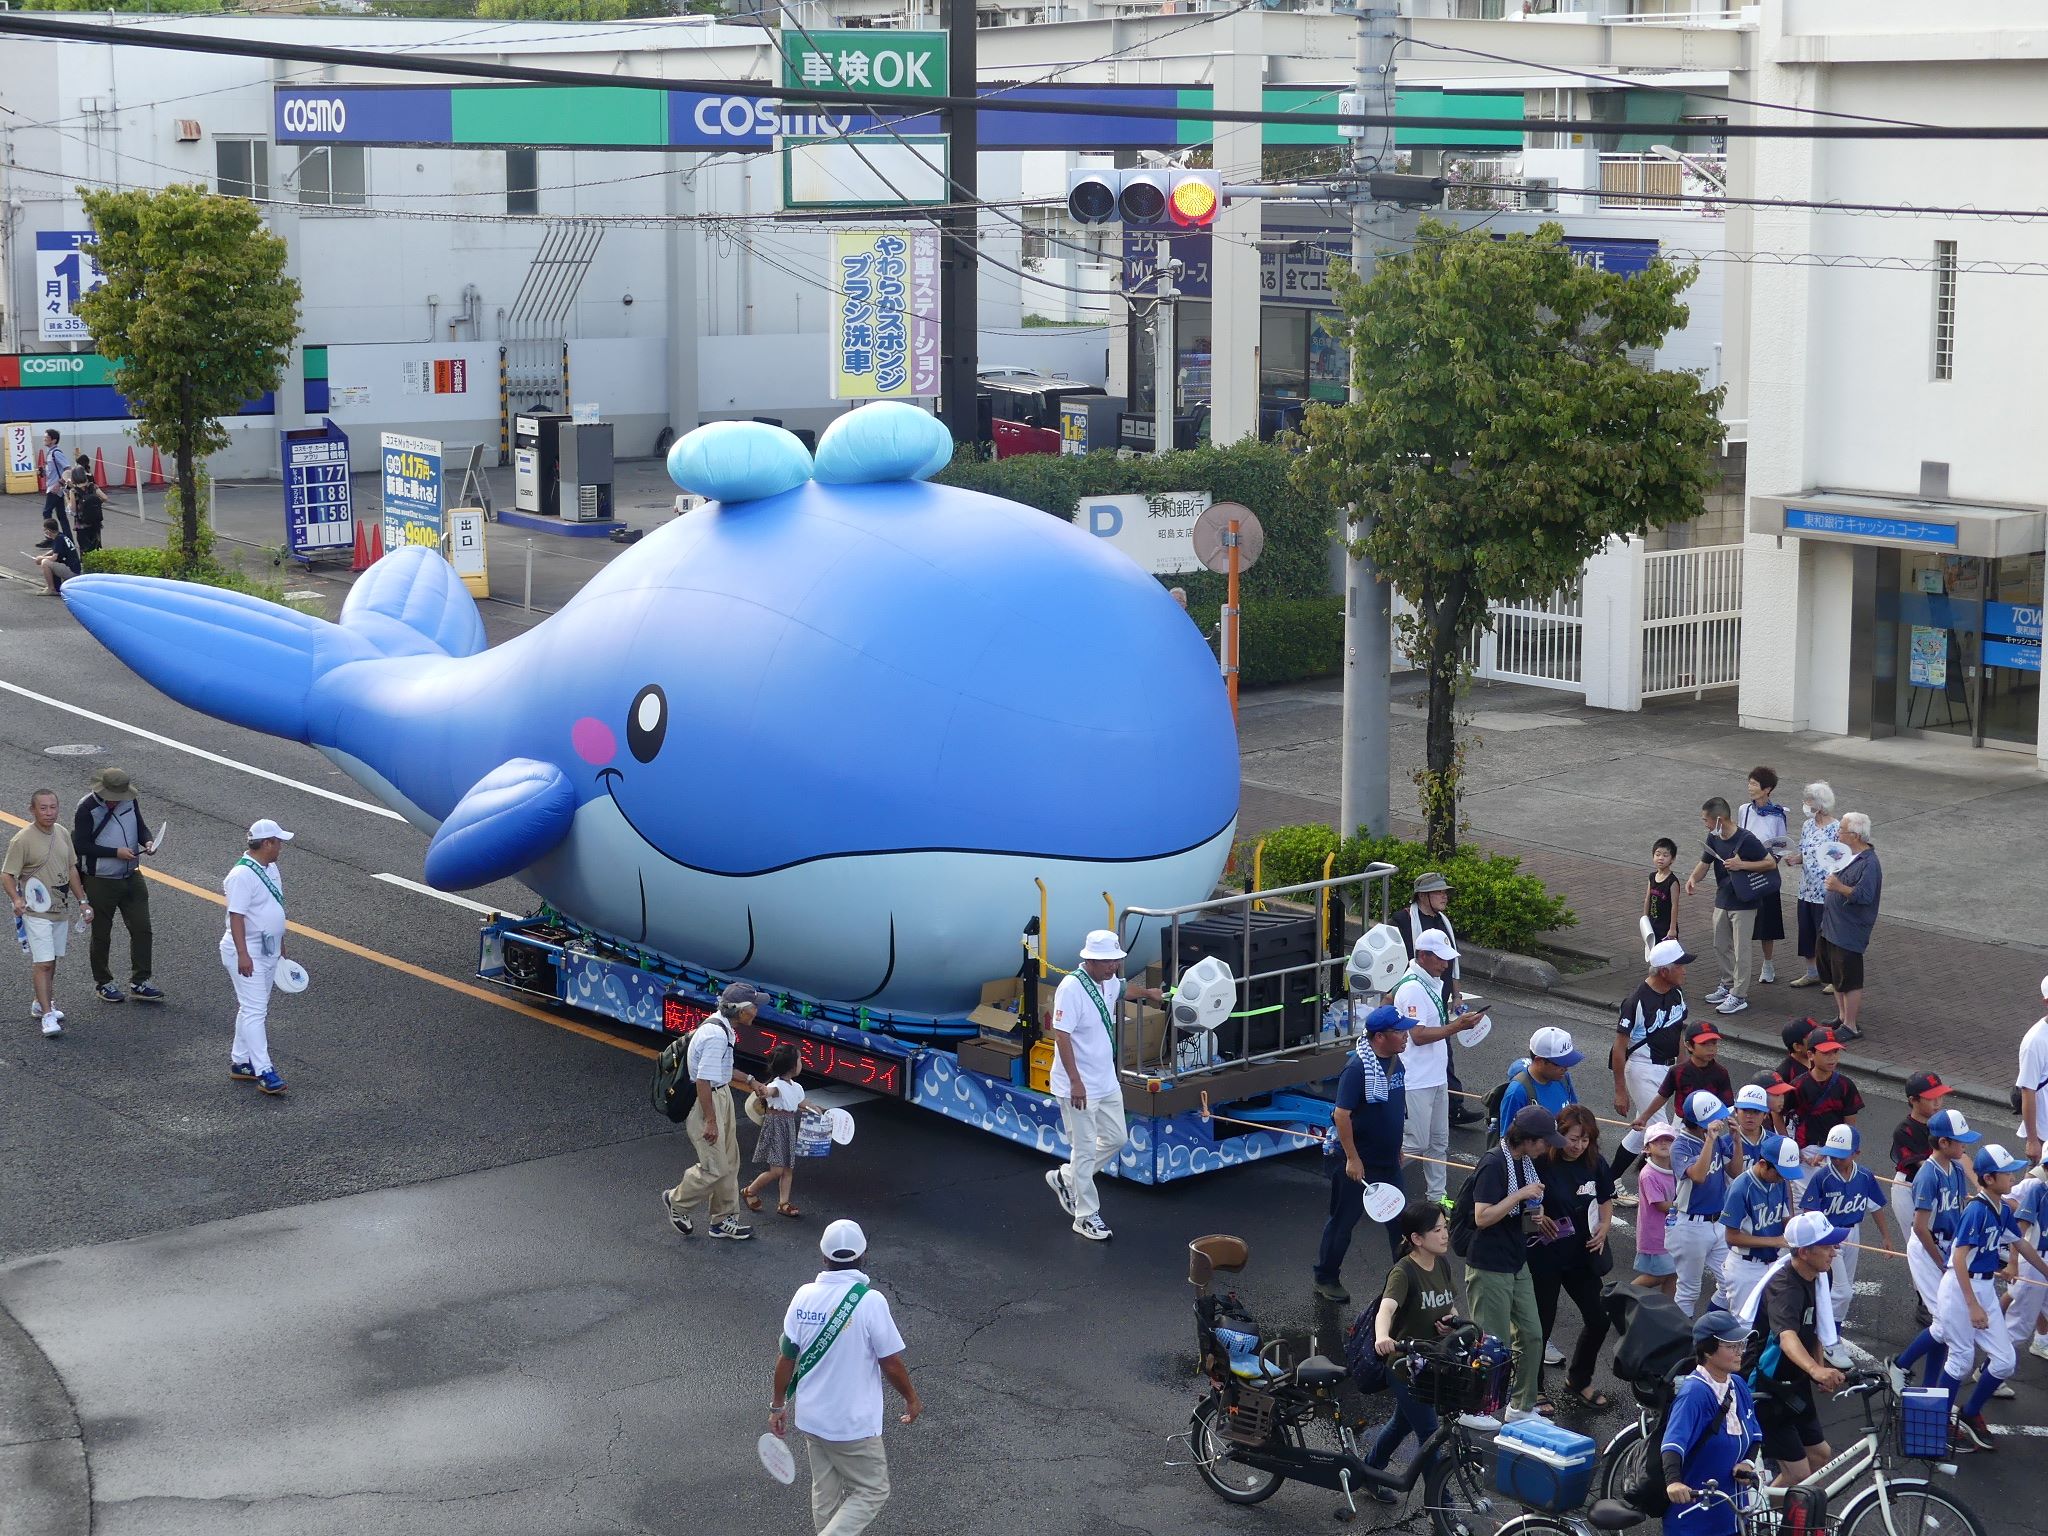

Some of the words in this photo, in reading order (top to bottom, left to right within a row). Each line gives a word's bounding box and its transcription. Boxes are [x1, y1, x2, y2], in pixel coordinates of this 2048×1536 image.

[801, 50, 932, 88] 車検OK
[284, 98, 346, 133] COSMO
[46, 281, 61, 314] 月々
[842, 252, 874, 375] ブラシ洗車
[875, 235, 906, 392] やわらかスポンジ
[914, 236, 935, 391] 洗車ステーション
[23, 358, 84, 373] COSMO
[14, 427, 27, 463] ガソリン
[15, 463, 32, 471] IN
[318, 466, 344, 481] 177
[319, 485, 346, 501] 188
[320, 506, 347, 521] 158
[1148, 499, 1205, 518] 東和銀行
[461, 520, 472, 546] 出口
[760, 1030, 897, 1090] フミリーライ
[1755, 1203, 1783, 1230] Met
[1824, 1192, 1867, 1216] Mets
[796, 1309, 827, 1323] Rotary
